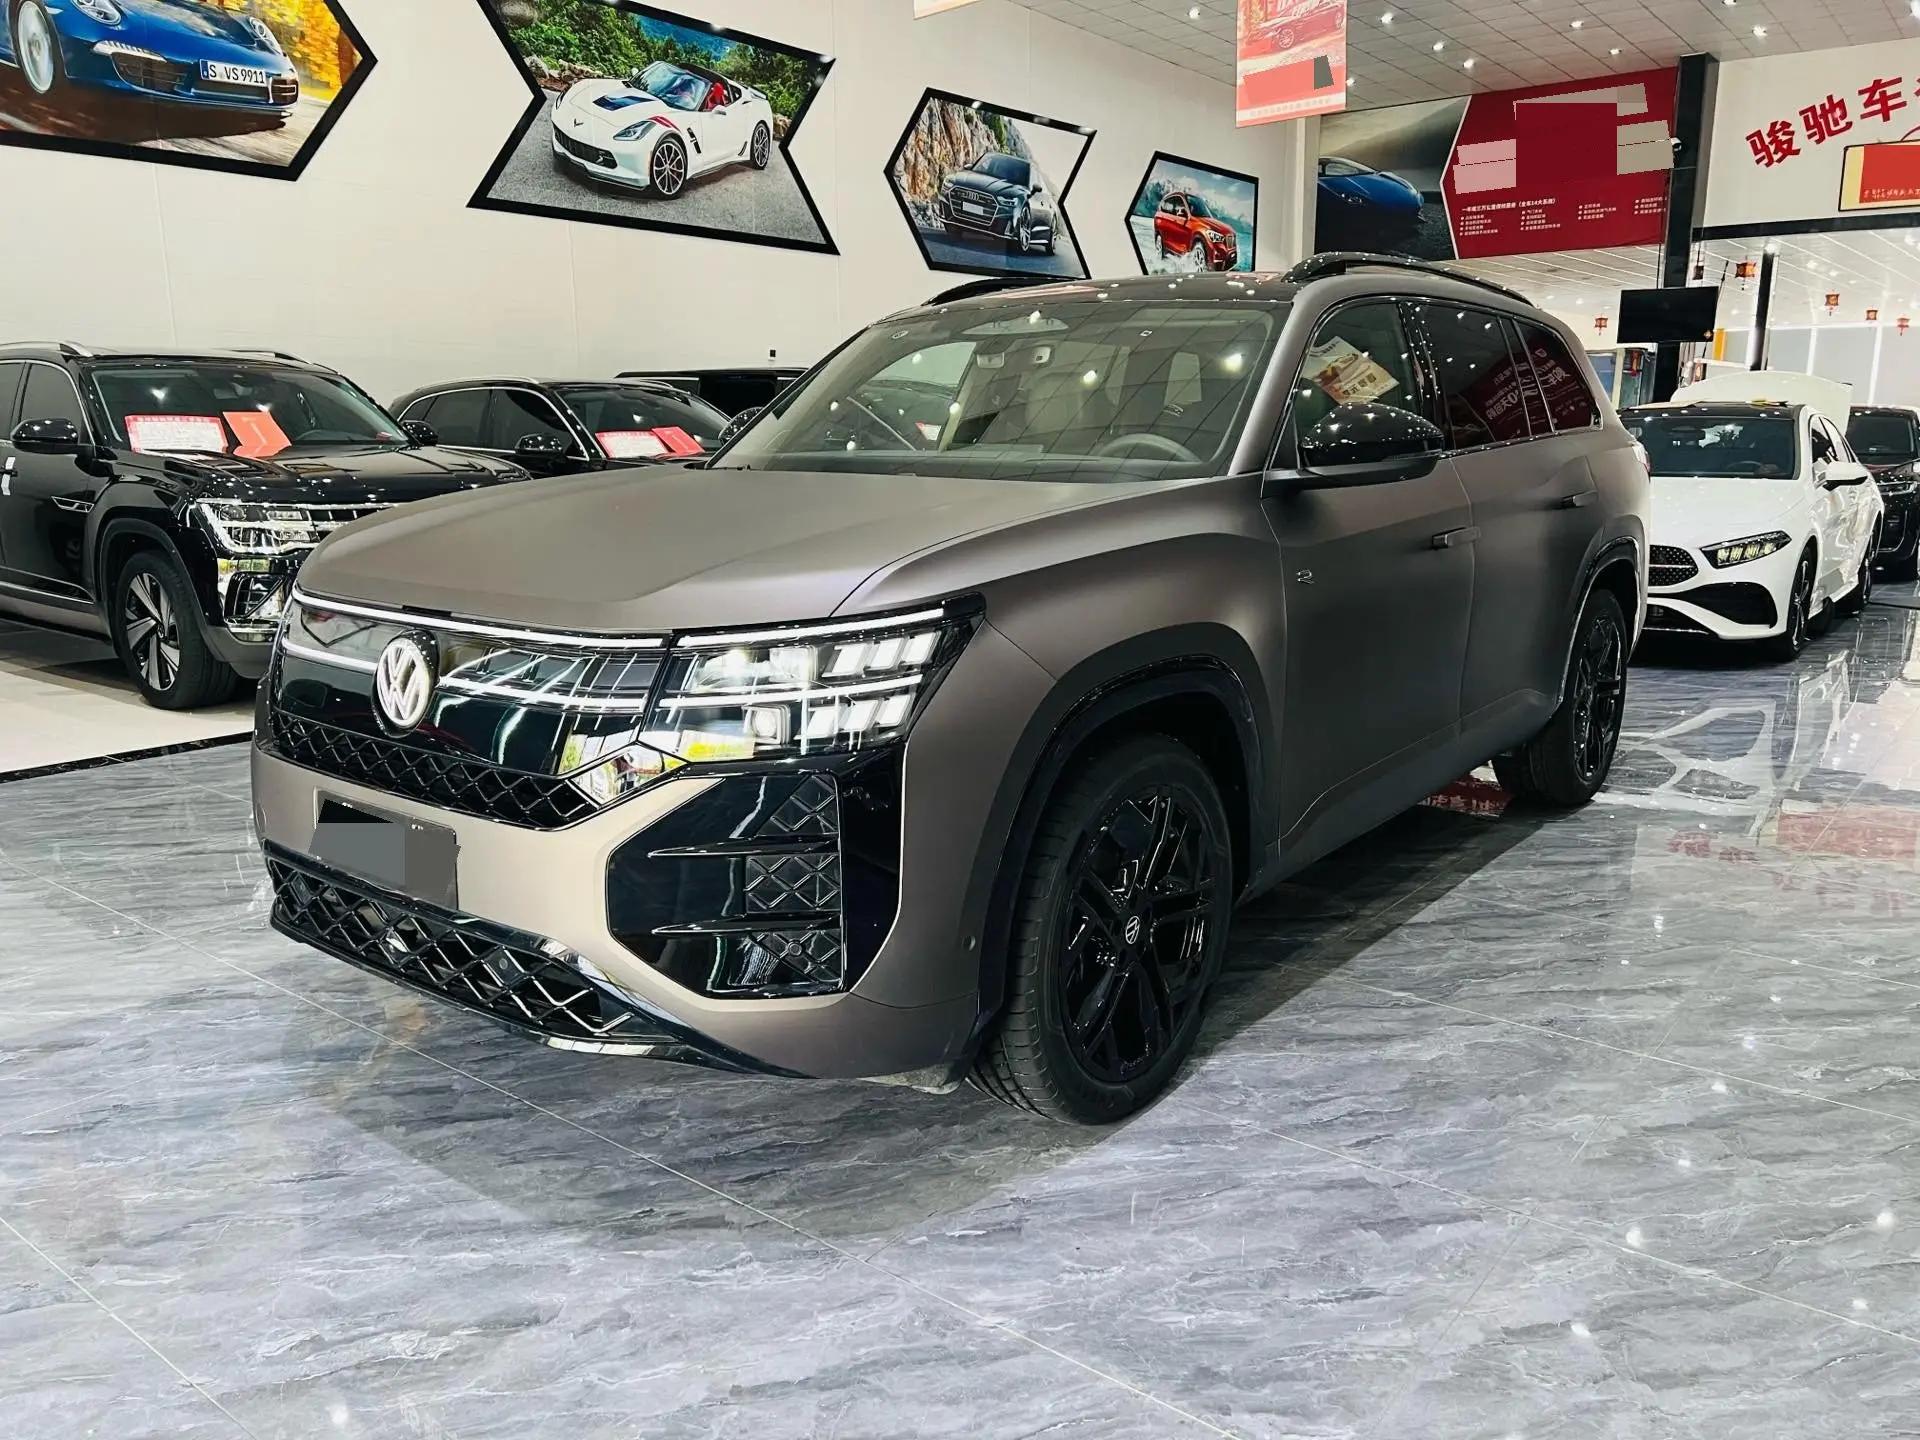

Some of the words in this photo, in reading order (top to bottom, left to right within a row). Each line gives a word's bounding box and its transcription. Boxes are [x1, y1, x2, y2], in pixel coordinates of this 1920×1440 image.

[209, 64, 217, 78] S
[224, 66, 239, 81] VS
[240, 68, 265, 84] 9911
[1745, 76, 1920, 168] 骏驰车
